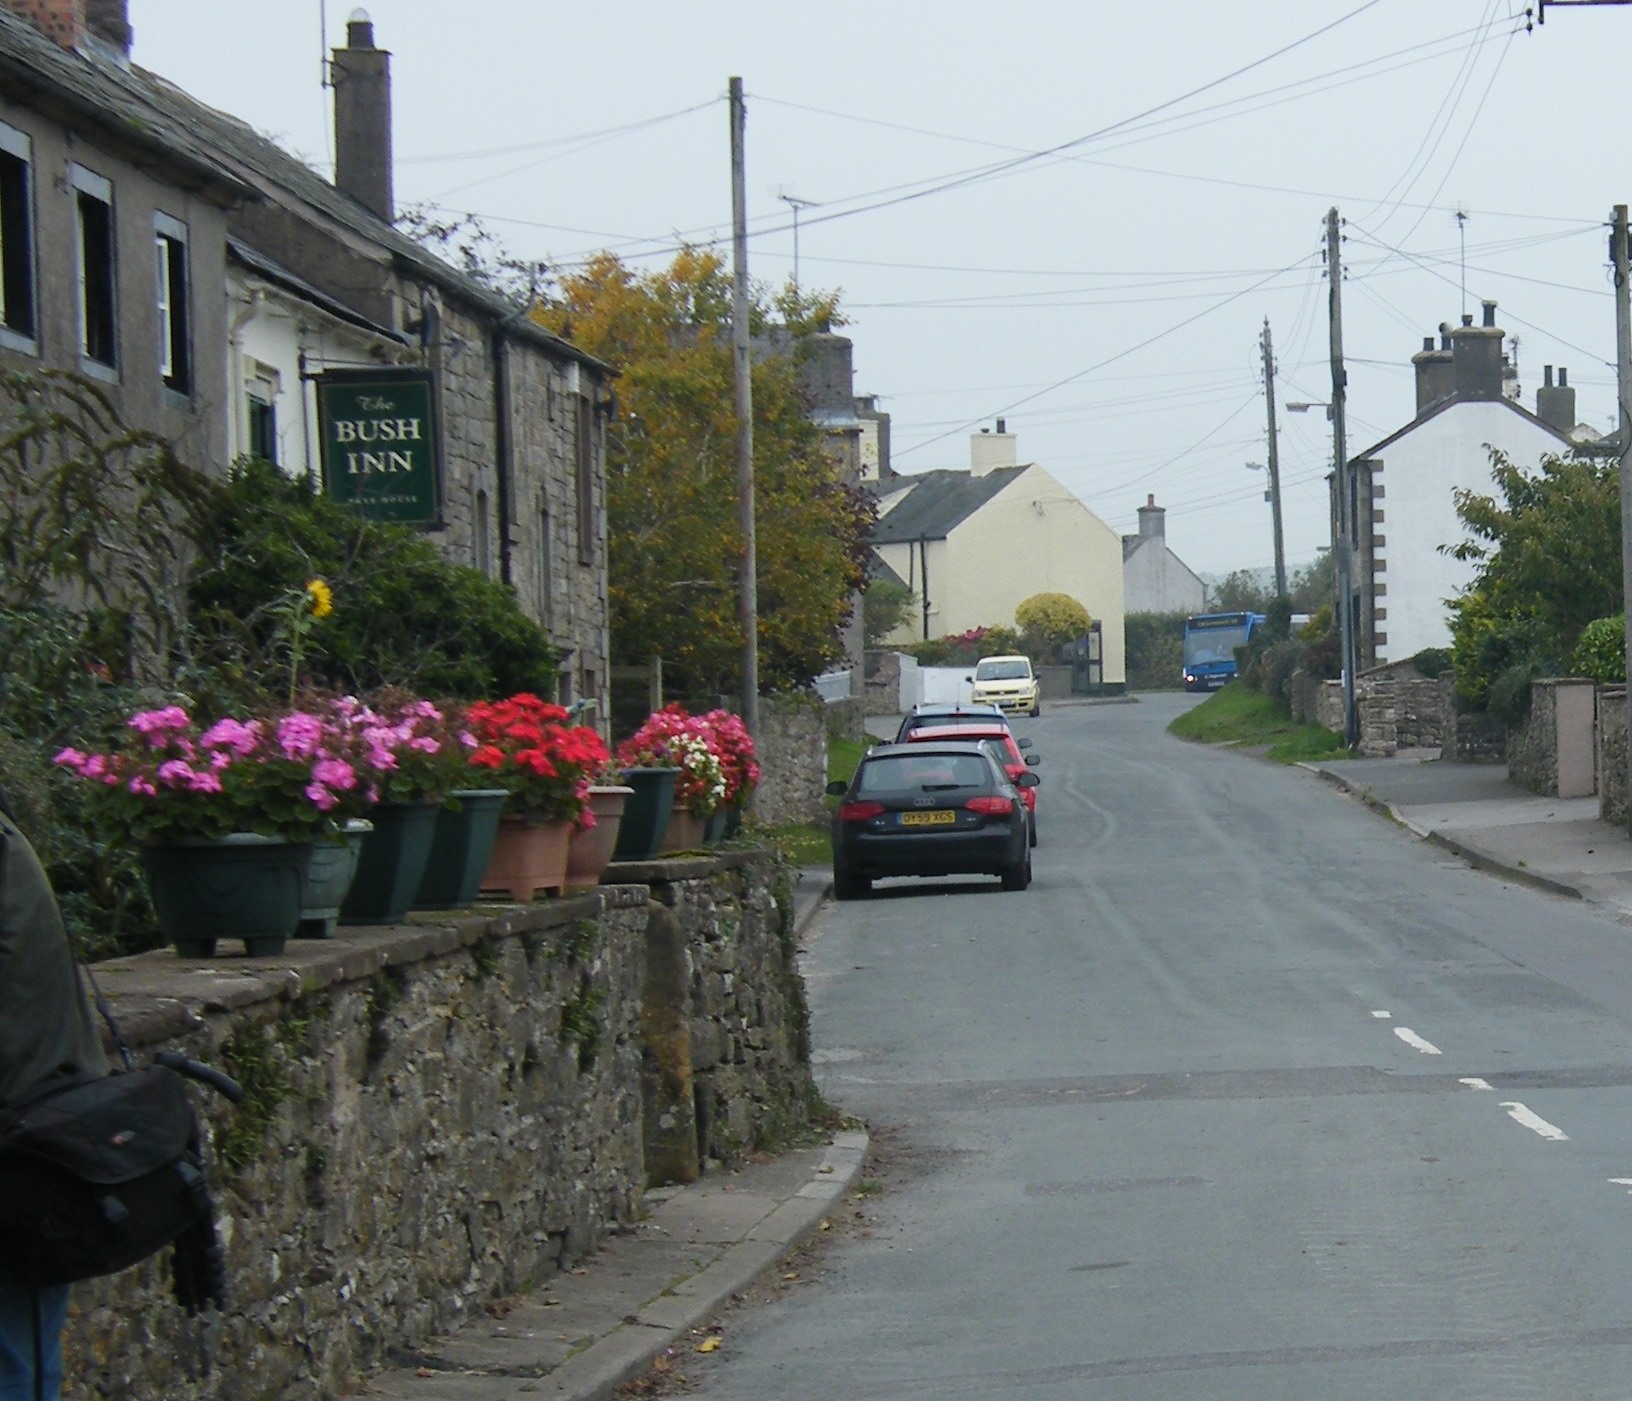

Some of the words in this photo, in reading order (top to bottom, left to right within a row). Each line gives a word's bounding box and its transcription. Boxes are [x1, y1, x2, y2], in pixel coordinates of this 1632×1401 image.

[355, 395, 395, 411] The
[334, 418, 423, 443] BUSH
[346, 451, 414, 474] INN
